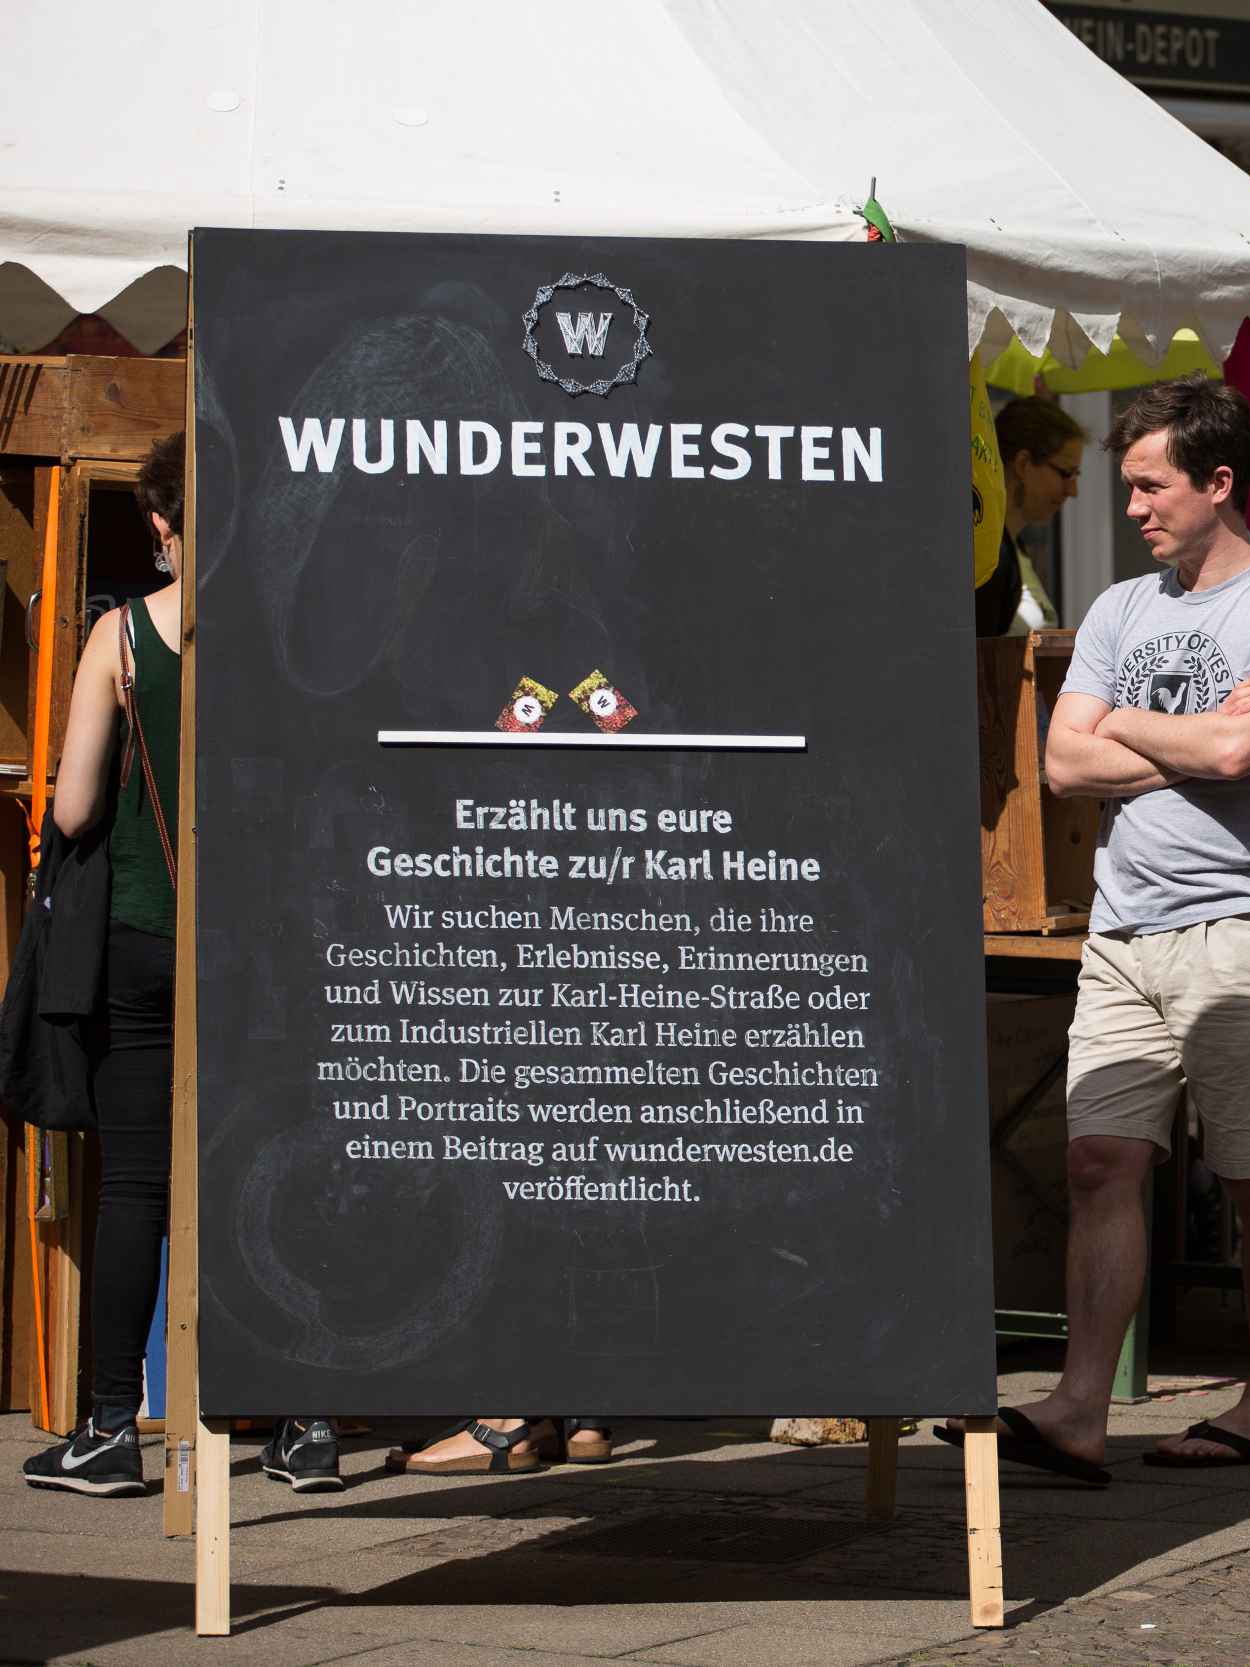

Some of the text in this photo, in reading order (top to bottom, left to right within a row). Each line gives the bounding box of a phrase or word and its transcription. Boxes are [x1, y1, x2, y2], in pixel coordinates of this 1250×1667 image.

[555, 311, 614, 356] W
[278, 416, 884, 482] WUNDERWESTEN
[1187, 633, 1210, 652] OF
[1207, 647, 1230, 683] YES
[455, 798, 733, 834] Erzählt uns eure
[366, 845, 821, 885] Geschichte zu/r Karl Heine
[383, 904, 814, 937] Wir suchen Menschen, die ihre
[326, 941, 869, 977] Geschichten, Erlebnisse, Erinnerungen
[323, 979, 871, 1010] und Wissen zur Karl-Heine-Straße oder
[330, 1018, 866, 1049] zum Industriellen Karl Heine erzählen
[316, 1055, 879, 1090] möchten. Die gesammelten Geschichten
[332, 1094, 865, 1125] und Portraits werden anschließend in
[345, 1133, 854, 1167] einem Beitrag auf wunderwesten.de
[501, 1174, 700, 1202] veröffentlicht.
[312, 1429, 331, 1441] NIKE
